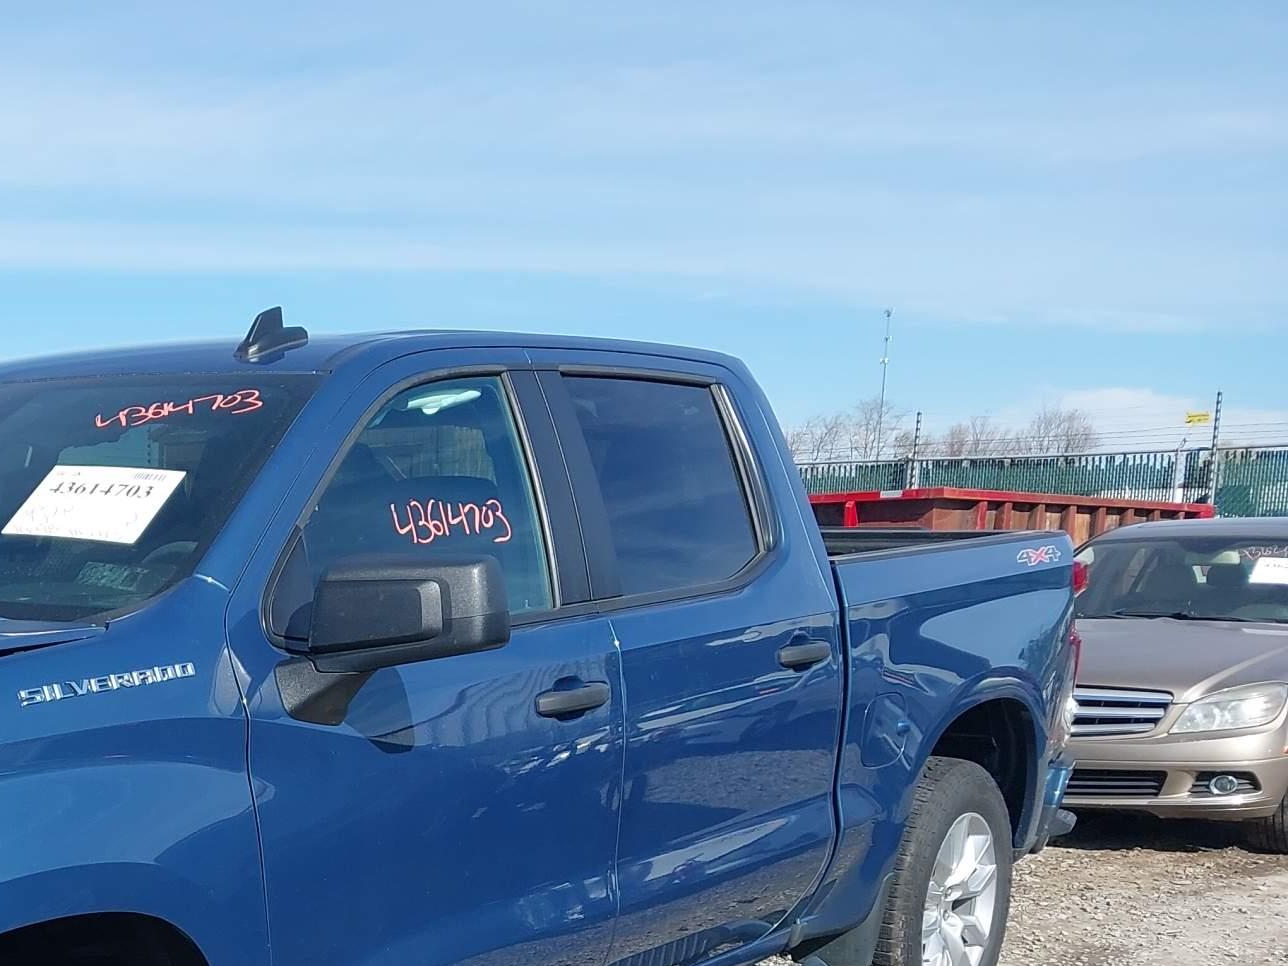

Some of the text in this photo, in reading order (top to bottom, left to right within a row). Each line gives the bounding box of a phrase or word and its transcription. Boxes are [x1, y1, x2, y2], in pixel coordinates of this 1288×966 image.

[94, 388, 264, 428] 43614703
[48, 481, 155, 499] 43614703
[390, 497, 512, 544] 43614703
[16, 662, 197, 707] SILVERADO
